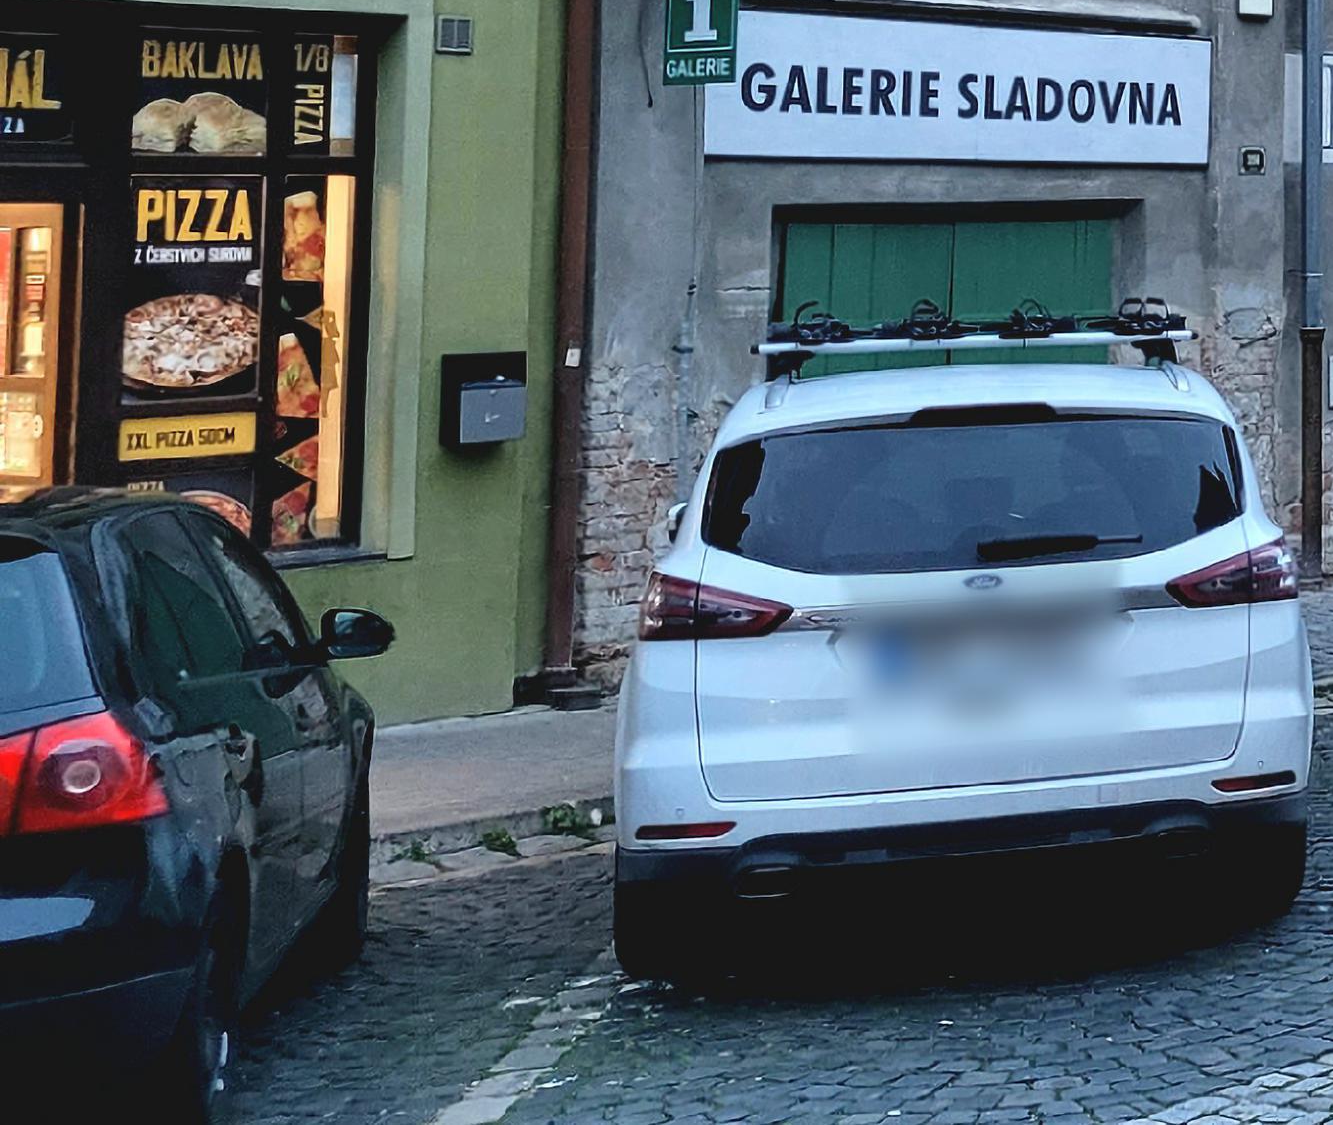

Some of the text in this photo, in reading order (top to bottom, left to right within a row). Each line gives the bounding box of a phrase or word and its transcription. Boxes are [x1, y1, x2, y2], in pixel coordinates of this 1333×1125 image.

[142, 40, 263, 80] BAKLAVA
[294, 43, 330, 72] 1/8
[666, 58, 731, 78] GALERIE
[740, 62, 1182, 126] GALERIE SLADOVNA
[294, 84, 325, 145] PIZZA
[136, 189, 253, 242] PIZZA
[127, 432, 151, 452] XXL
[156, 429, 194, 449] PIZZA
